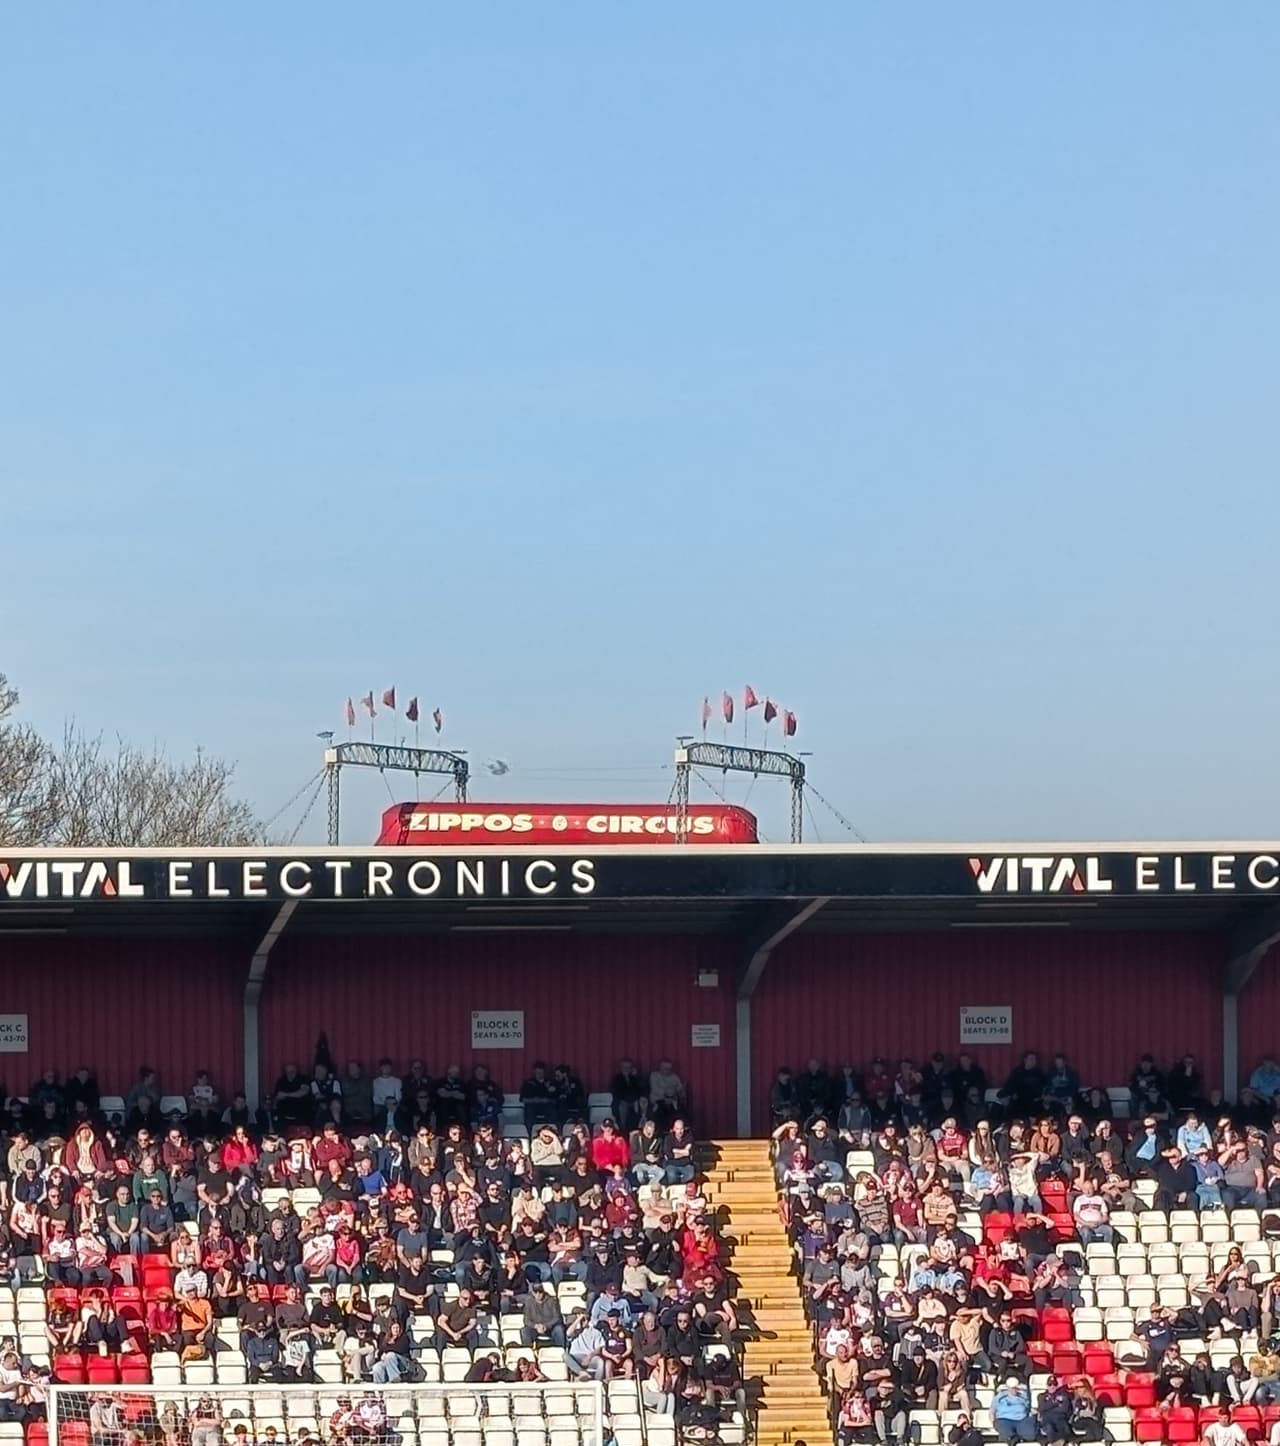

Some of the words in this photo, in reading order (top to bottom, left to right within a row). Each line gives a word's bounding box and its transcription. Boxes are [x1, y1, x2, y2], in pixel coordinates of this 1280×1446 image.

[407, 812, 534, 833] ZIPPOS
[586, 814, 715, 835] CIRCUS
[167, 859, 597, 897] ELECTRONICS
[968, 856, 1112, 893] VITAL
[476, 1020, 510, 1029] BLOCK
[512, 1020, 520, 1029] C
[965, 1016, 997, 1025] BLOCK
[999, 1016, 1007, 1025] D
[15, 1024, 23, 1033] C
[963, 1027, 987, 1035] SEATS
[474, 1031, 498, 1039] SEATS
